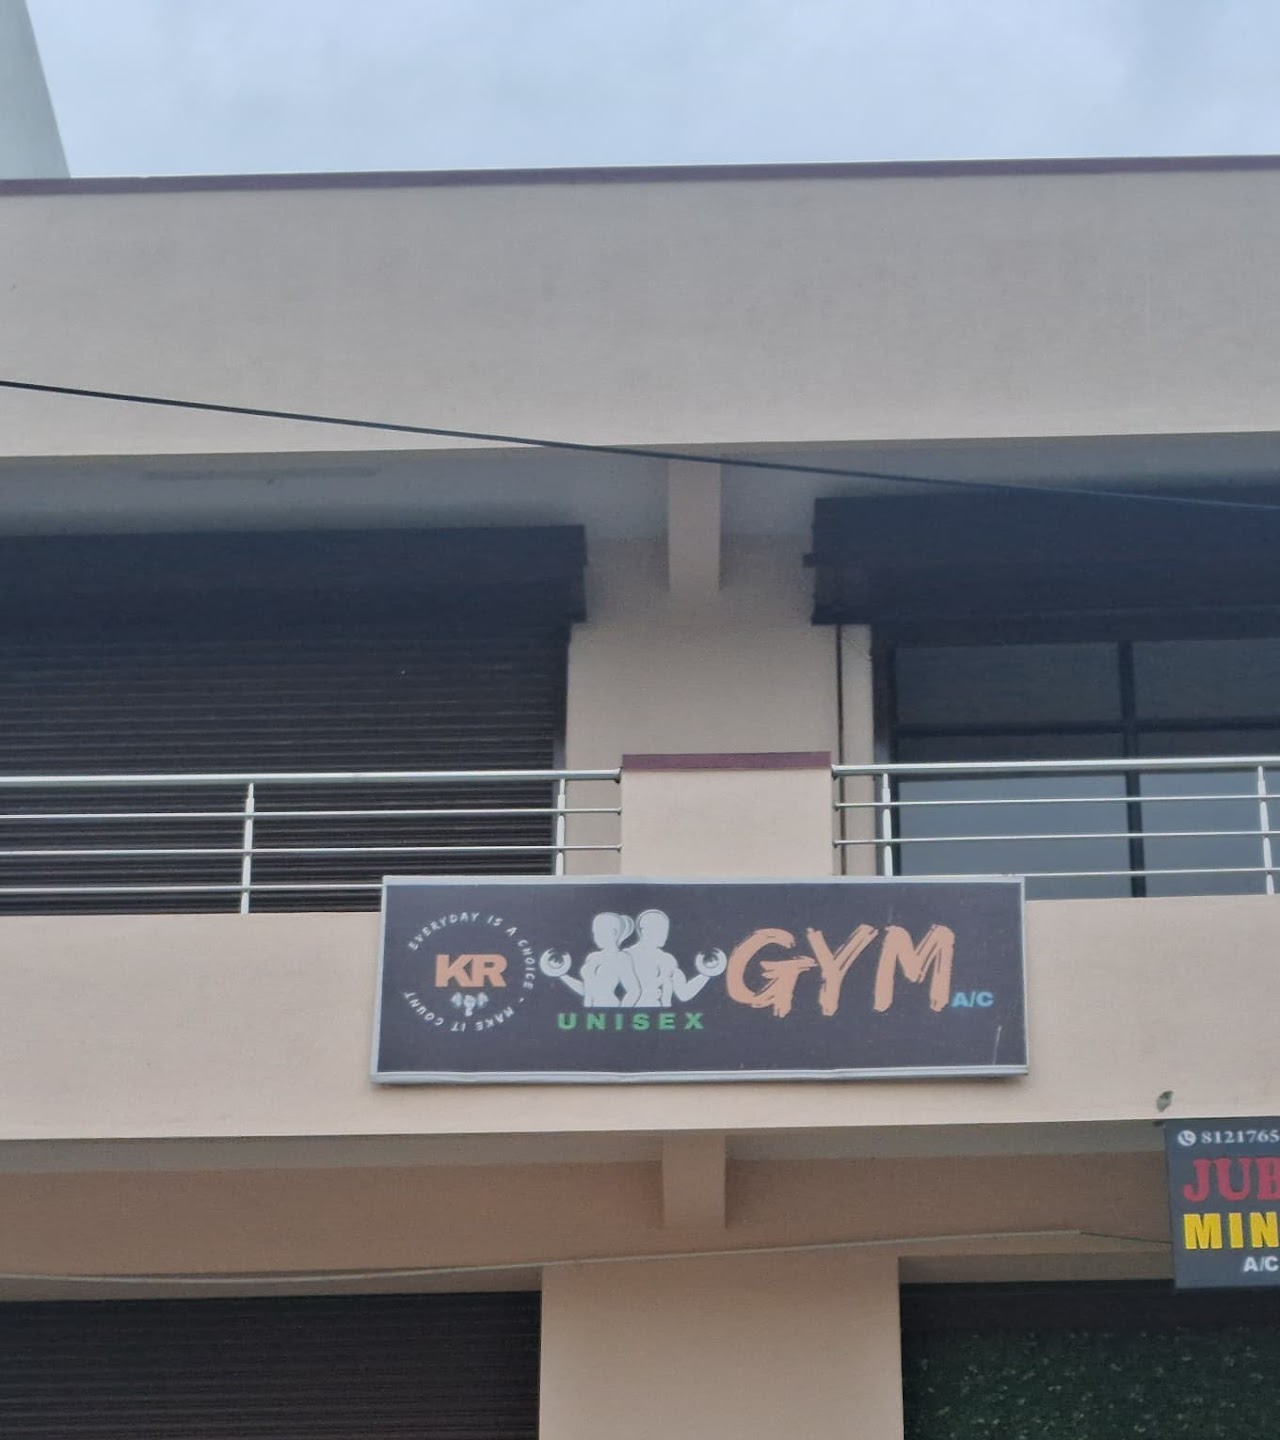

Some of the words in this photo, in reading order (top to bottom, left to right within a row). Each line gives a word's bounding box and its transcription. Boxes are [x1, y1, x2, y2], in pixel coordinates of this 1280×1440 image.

[408, 912, 480, 951] EVERYDAY
[487, 915, 503, 927] IS
[506, 926, 518, 937] A
[435, 953, 508, 987] KR
[517, 939, 536, 990] CHOICE
[726, 923, 956, 1018] GYM
[952, 991, 995, 1008] A/C
[403, 991, 445, 1026] COUNT
[475, 1006, 515, 1031] MAKE
[557, 1012, 704, 1030] UNISEX
[450, 1022, 467, 1032] IT
[1242, 1256, 1280, 1272] A/C
